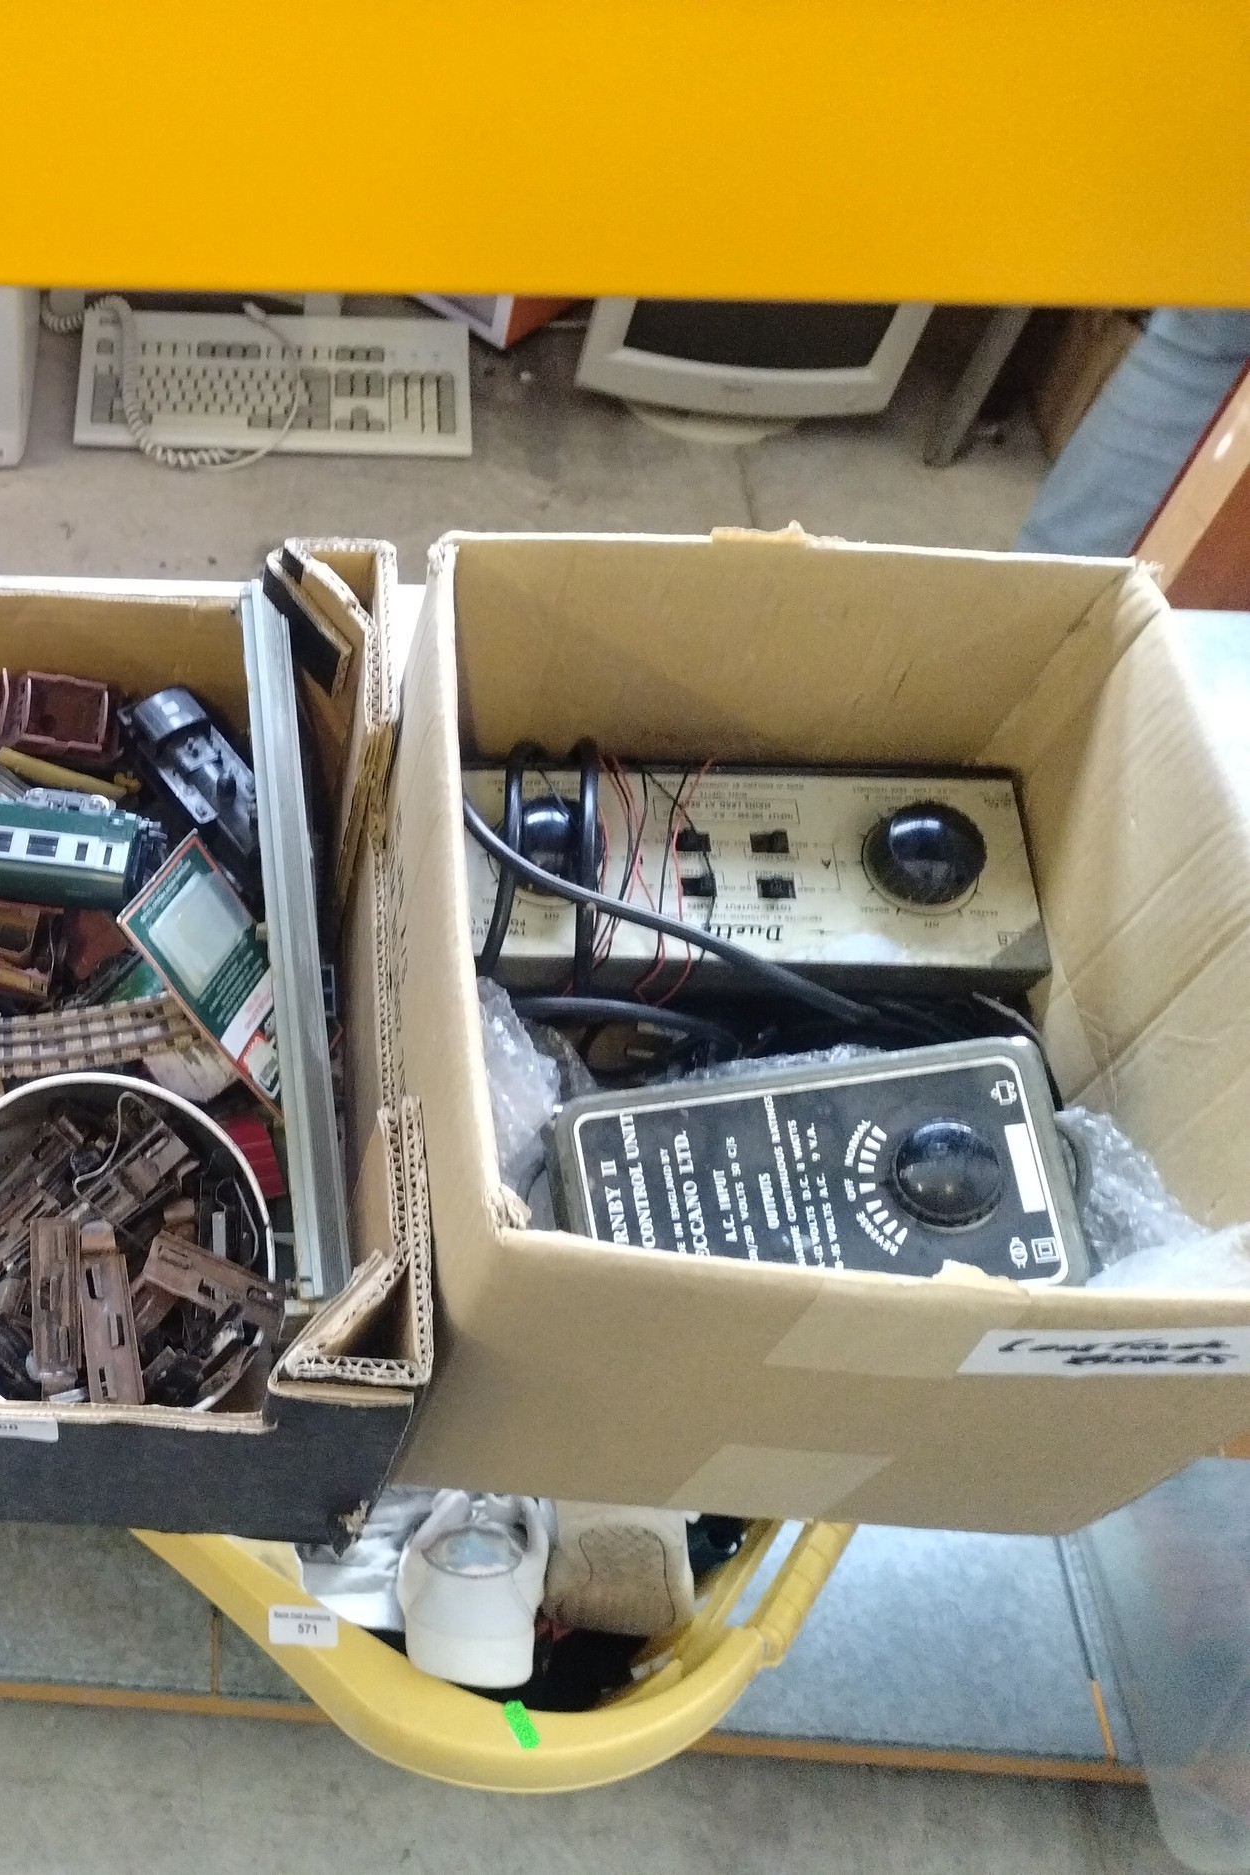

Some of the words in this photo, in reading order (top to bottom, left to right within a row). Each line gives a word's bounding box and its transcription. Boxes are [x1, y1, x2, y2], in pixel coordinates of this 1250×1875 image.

[703, 923, 783, 942] Duett
[620, 1114, 639, 1160] UNIT
[764, 1095, 780, 1144] RATINGS
[788, 1119, 802, 1161] WATTS
[806, 1122, 817, 1150] V.A.
[660, 1148, 670, 1165] BY
[674, 1129, 694, 1175] LTD.
[844, 1119, 871, 1167] NORMAL
[713, 1169, 731, 1211] INPUT
[731, 1162, 741, 1177] 50
[774, 1146, 796, 1222] CONTINUOUS
[800, 1174, 811, 1201] D.C.
[816, 1173, 828, 1199] A.C.
[844, 1178, 856, 1202] OFF
[629, 1162, 655, 1248] CONTROL
[663, 1165, 681, 1221] ENGLAND
[735, 1182, 749, 1221] VOLTS
[758, 1173, 780, 1229] OUTPUTS
[604, 1186, 629, 1245] RNBY
[674, 1222, 683, 1238] IN
[683, 1180, 710, 1257] ECCANO
[723, 1214, 737, 1242] A.C.
[805, 1205, 820, 1246] VOLTS
[822, 1202, 837, 1243] VOLTS
[855, 1211, 899, 1256] REVERSE
[676, 1241, 688, 1254] DE
[297, 1622, 318, 1635] 571
